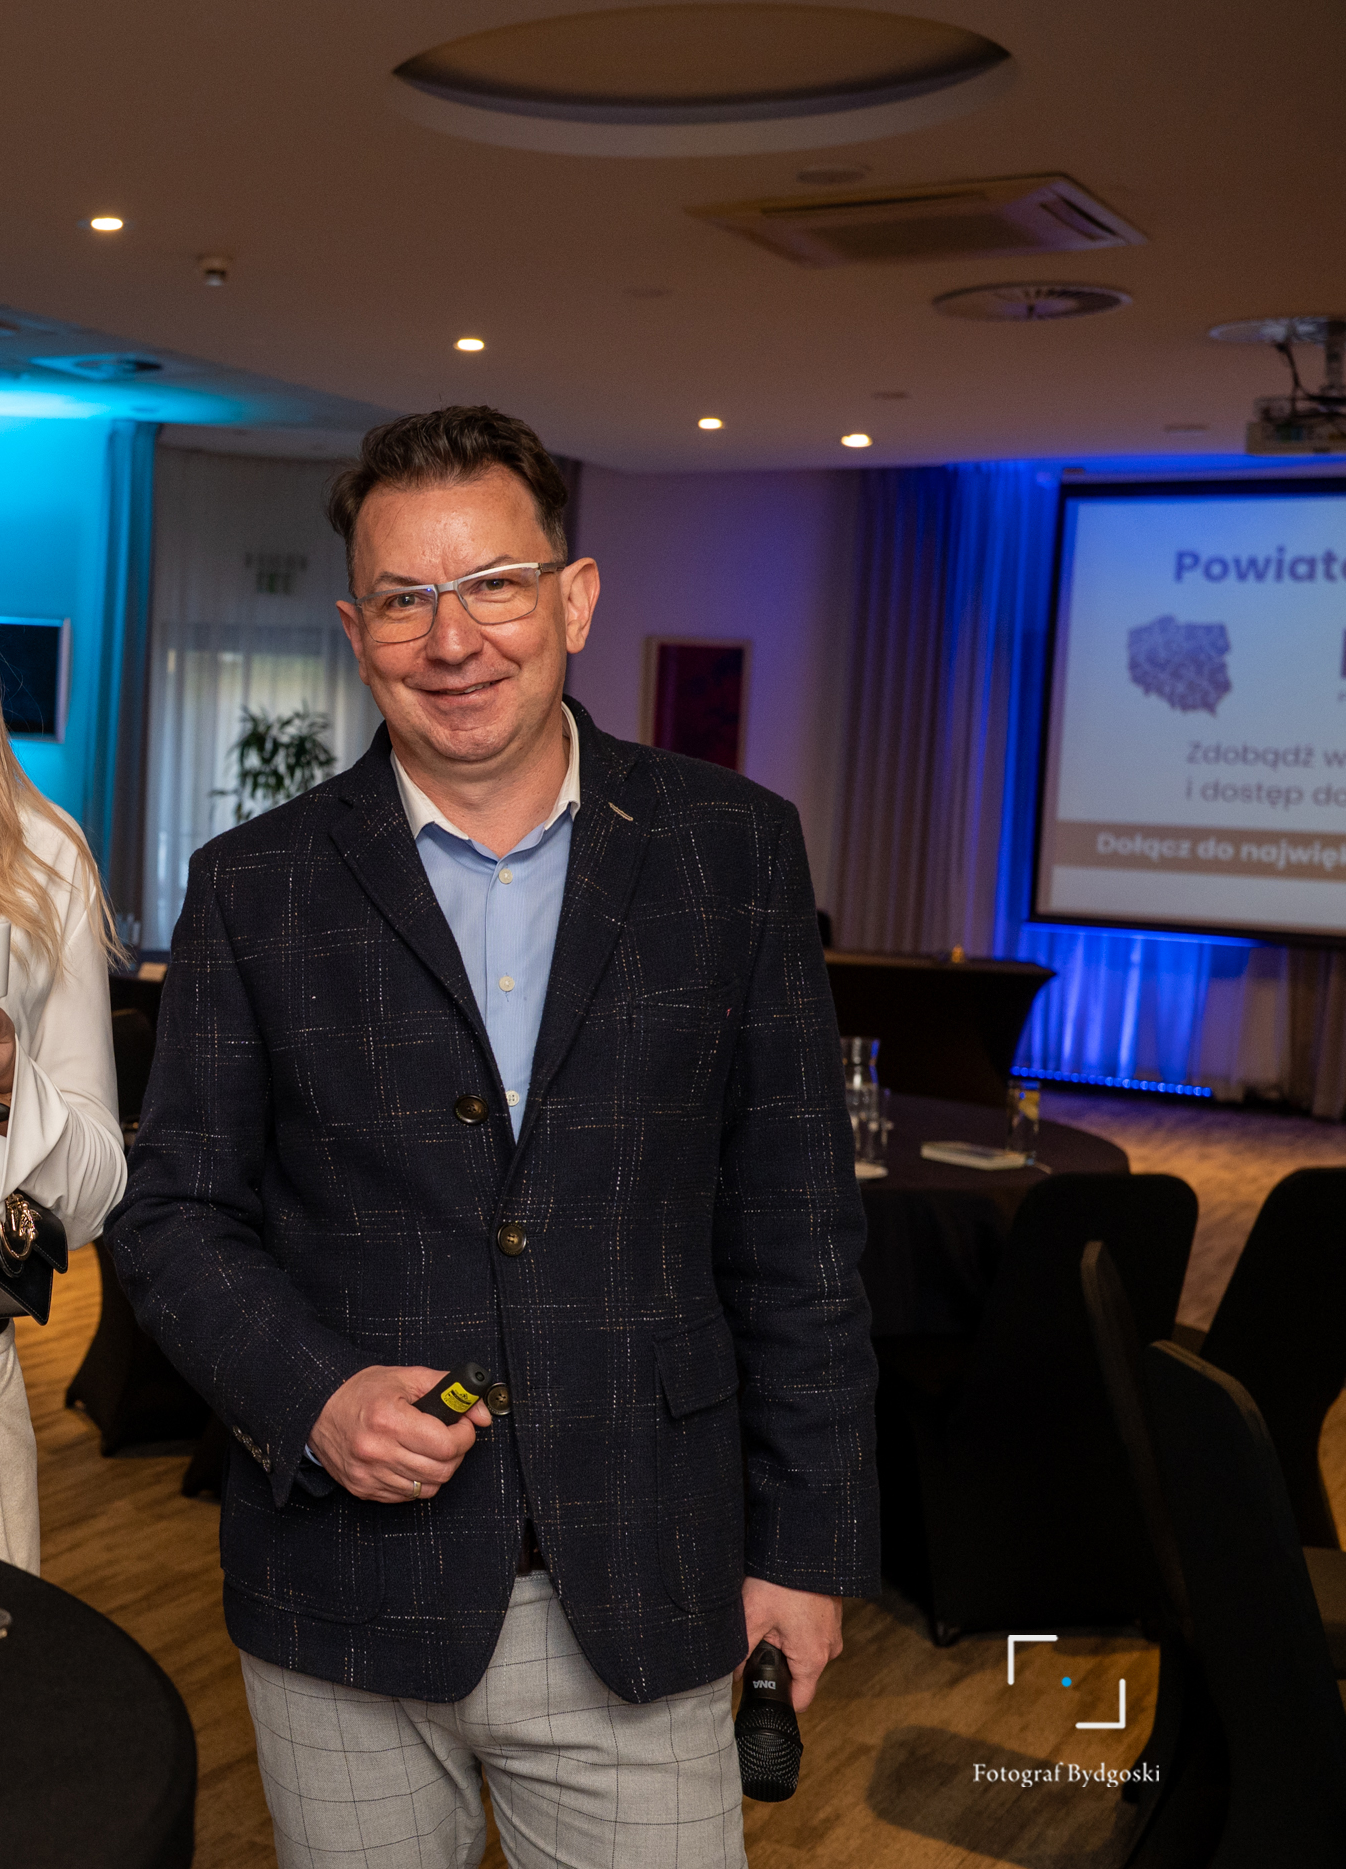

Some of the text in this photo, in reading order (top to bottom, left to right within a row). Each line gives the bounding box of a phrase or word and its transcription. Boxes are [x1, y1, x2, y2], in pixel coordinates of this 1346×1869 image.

[1174, 544, 1346, 583] Powiat
[1186, 740, 1315, 773] Zdobądź
[1200, 778, 1305, 812] dostęp
[1197, 836, 1235, 861] do
[753, 1680, 776, 1690] DNA
